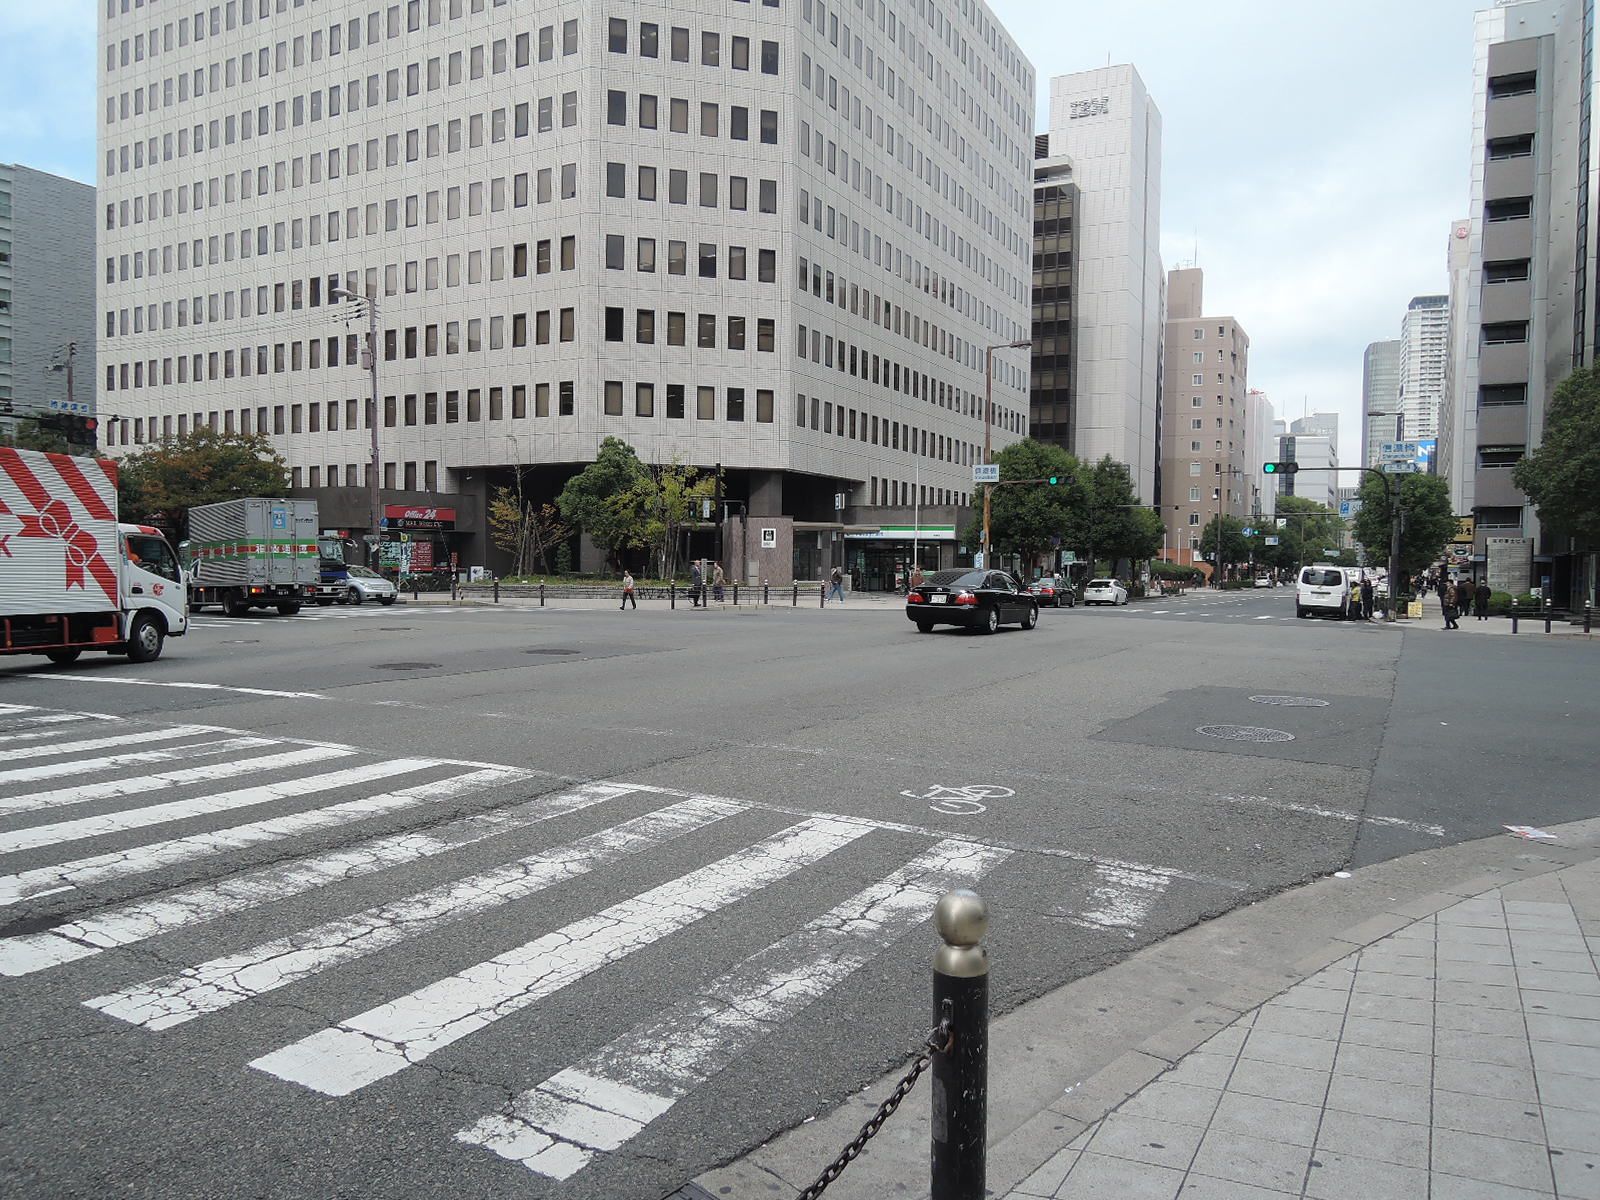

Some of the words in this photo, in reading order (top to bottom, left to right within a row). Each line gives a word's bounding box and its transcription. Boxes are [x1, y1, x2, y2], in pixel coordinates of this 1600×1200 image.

[1070, 96, 1109, 119] IBM
[404, 510, 423, 519] Office
[423, 508, 437, 520] 24
